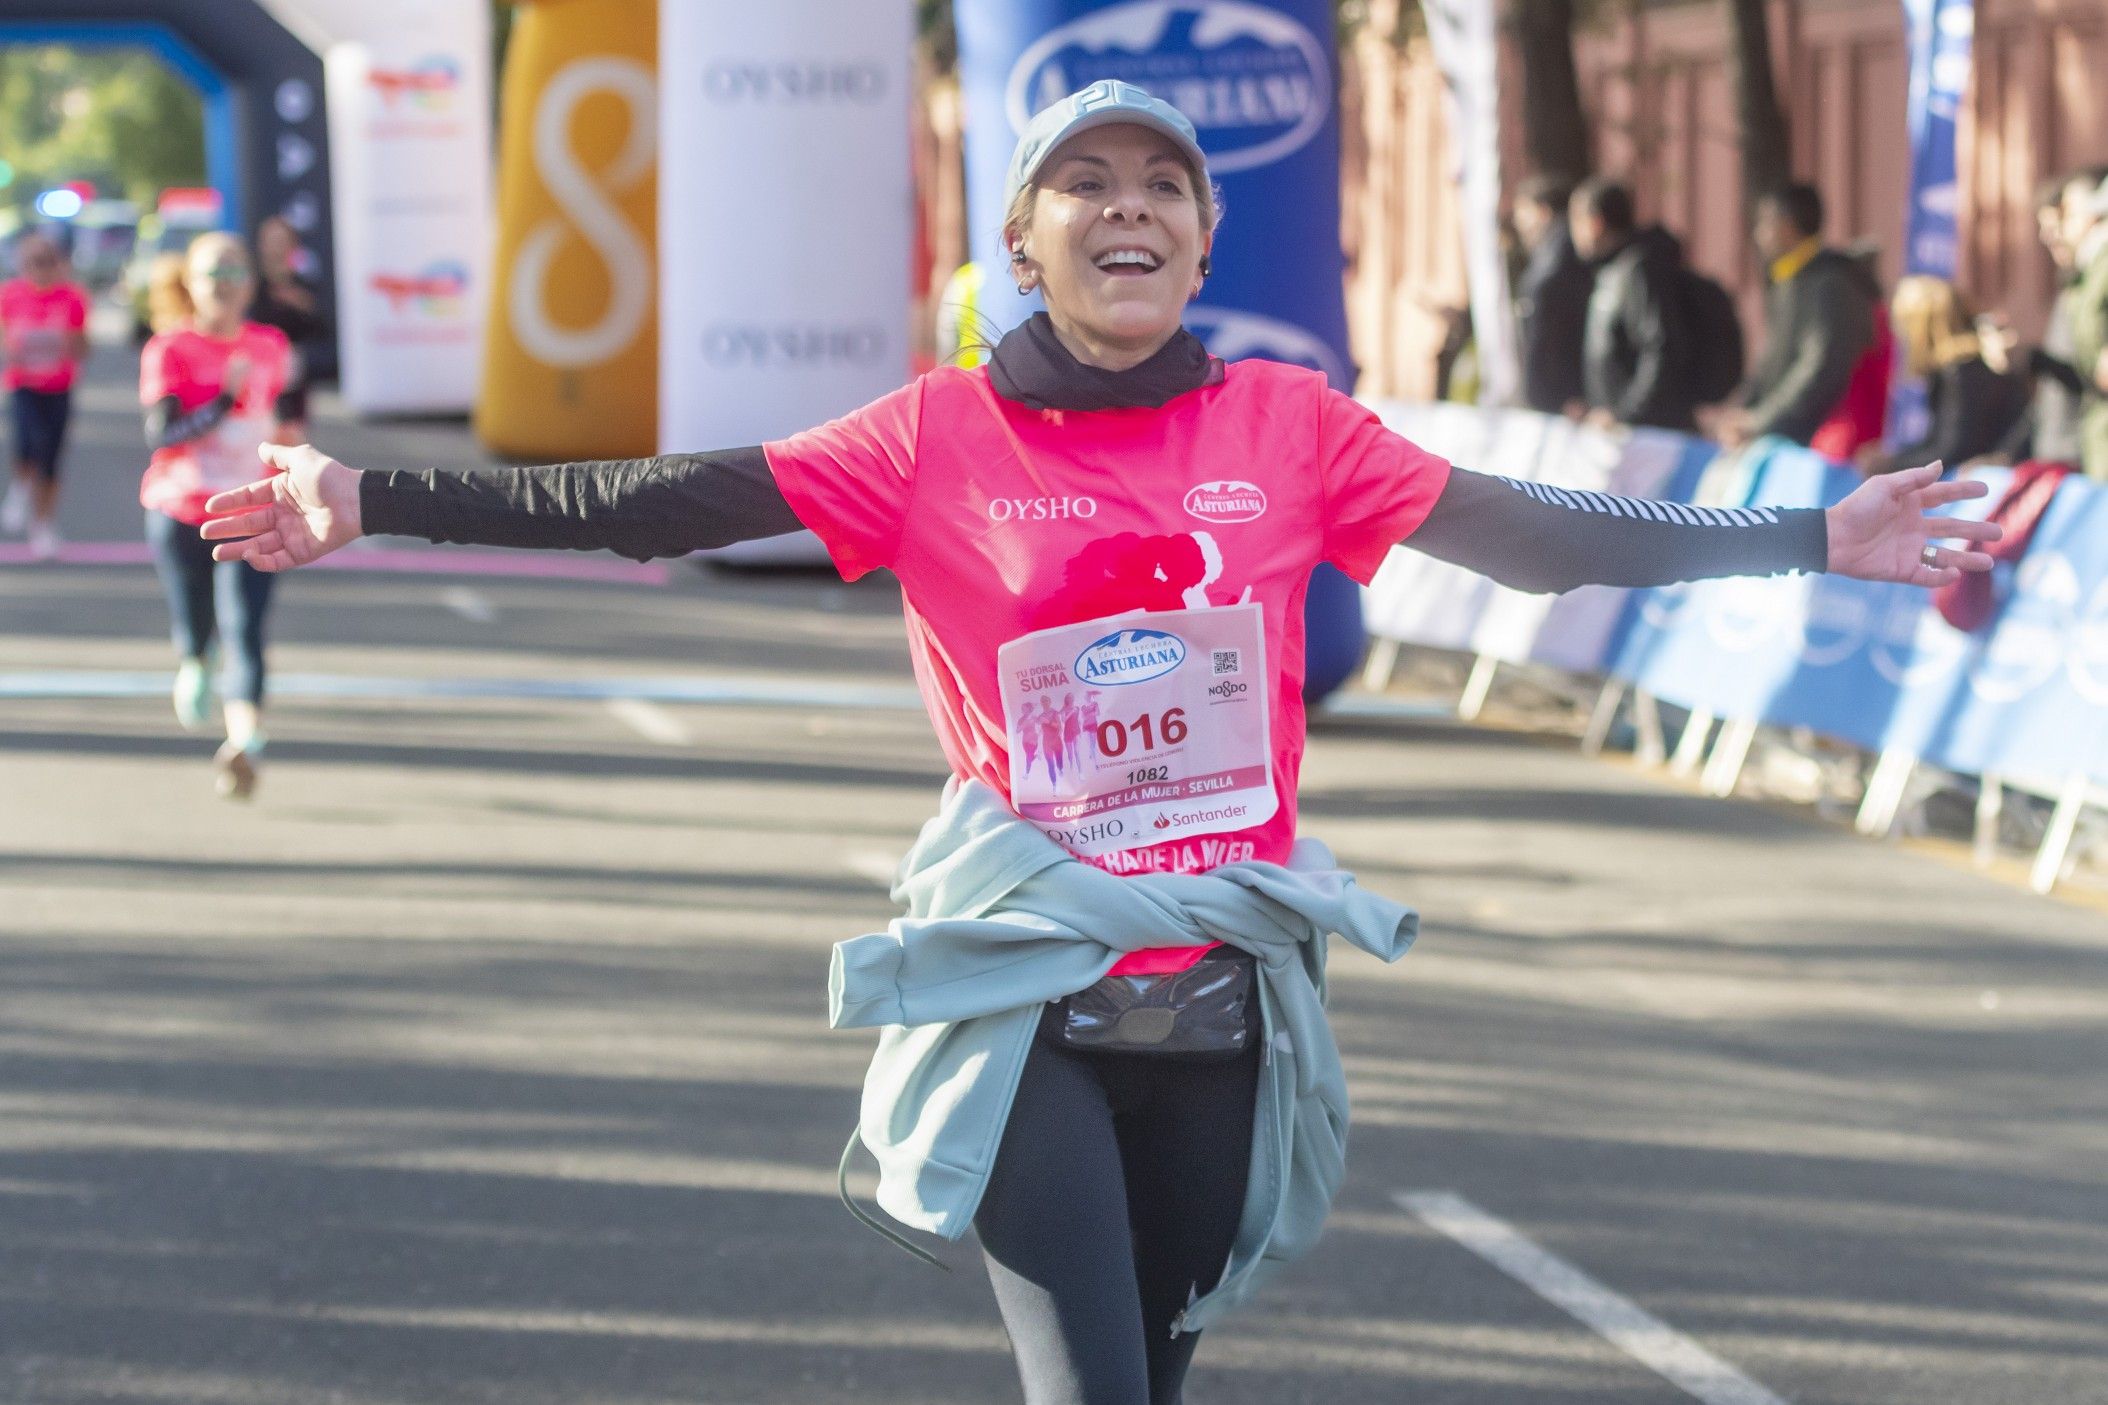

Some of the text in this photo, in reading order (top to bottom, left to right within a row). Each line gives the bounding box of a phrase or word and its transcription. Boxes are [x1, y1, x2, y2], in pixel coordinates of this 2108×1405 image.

[703, 62, 887, 104] OYSHO
[702, 323, 886, 367] OYSHO
[988, 496, 1097, 521] OYSHO
[1192, 494, 1261, 513] ASTURIANA
[1014, 662, 1066, 679] TU DORSAL
[1085, 648, 1179, 679] ASTURIANA
[1020, 672, 1070, 692] SUMA
[1096, 707, 1187, 757] 016
[1127, 765, 1168, 785] 1082
[1053, 776, 1233, 819] CARRERA DE LA MUJER SEVILLA
[1173, 804, 1248, 826] Santander
[1173, 845, 1200, 874] LA
